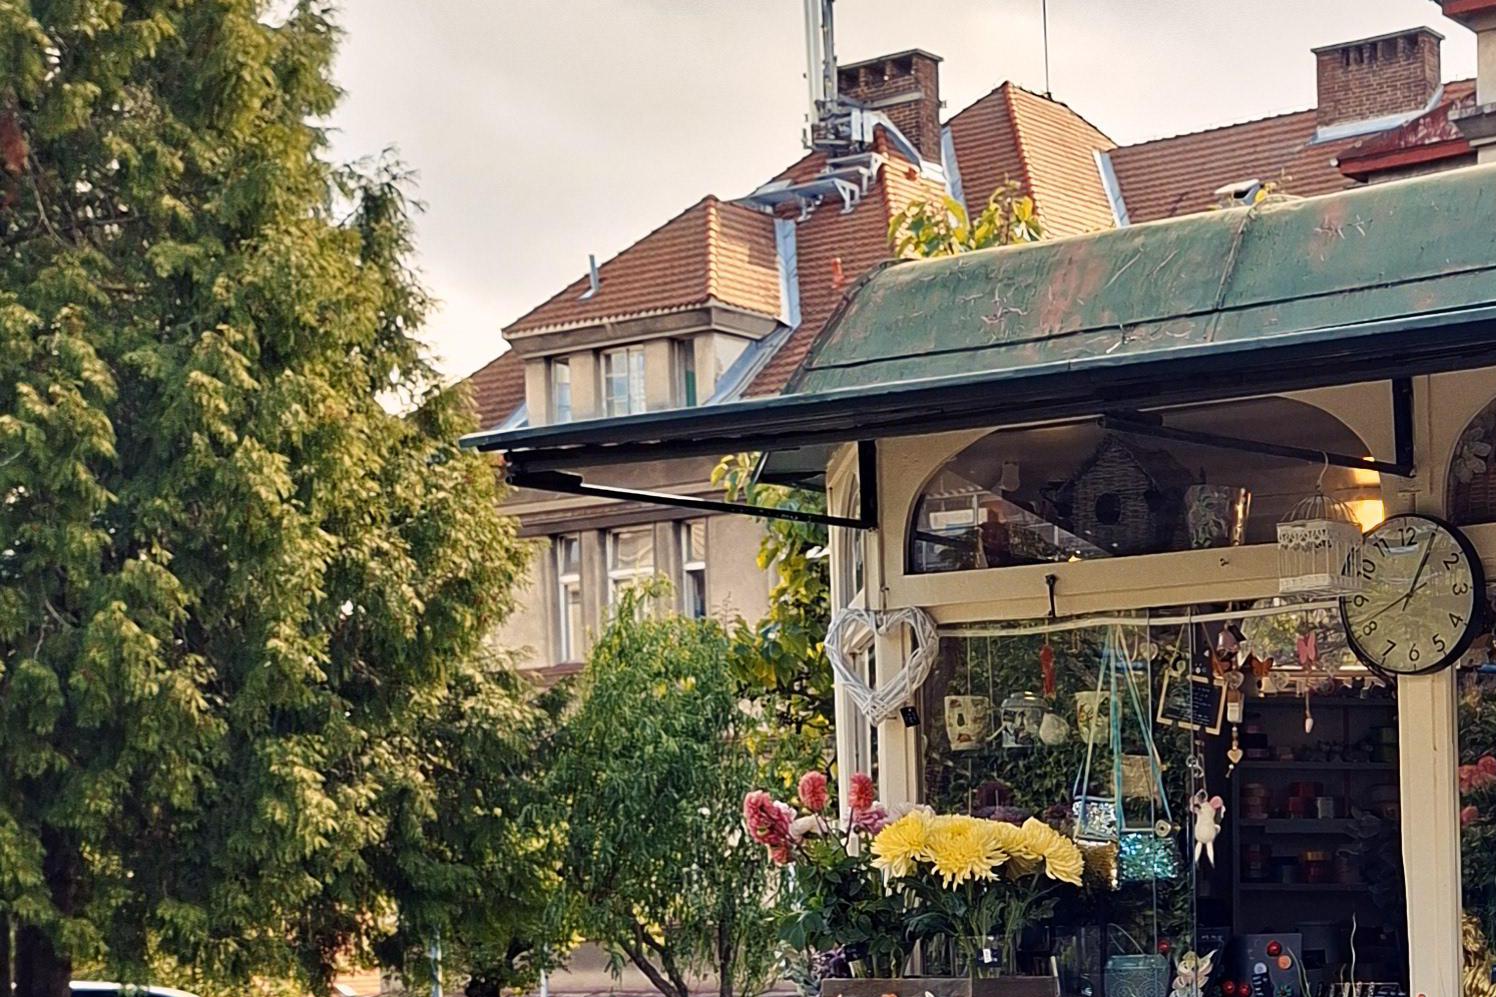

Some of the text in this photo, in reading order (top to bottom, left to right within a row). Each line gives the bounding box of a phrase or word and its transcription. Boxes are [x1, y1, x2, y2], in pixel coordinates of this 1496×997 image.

[1398, 527, 1418, 547] 12
[1373, 537, 1391, 558] 11
[1357, 558, 1376, 581] 10
[1442, 552, 1459, 570] 2
[1452, 582, 1468, 596] 3
[1353, 594, 1369, 608] 9
[1362, 620, 1378, 636] 8
[1448, 612, 1464, 628] 4
[1382, 639, 1396, 657] 7
[1432, 633, 1446, 653] 5
[1408, 643, 1420, 662] 6
